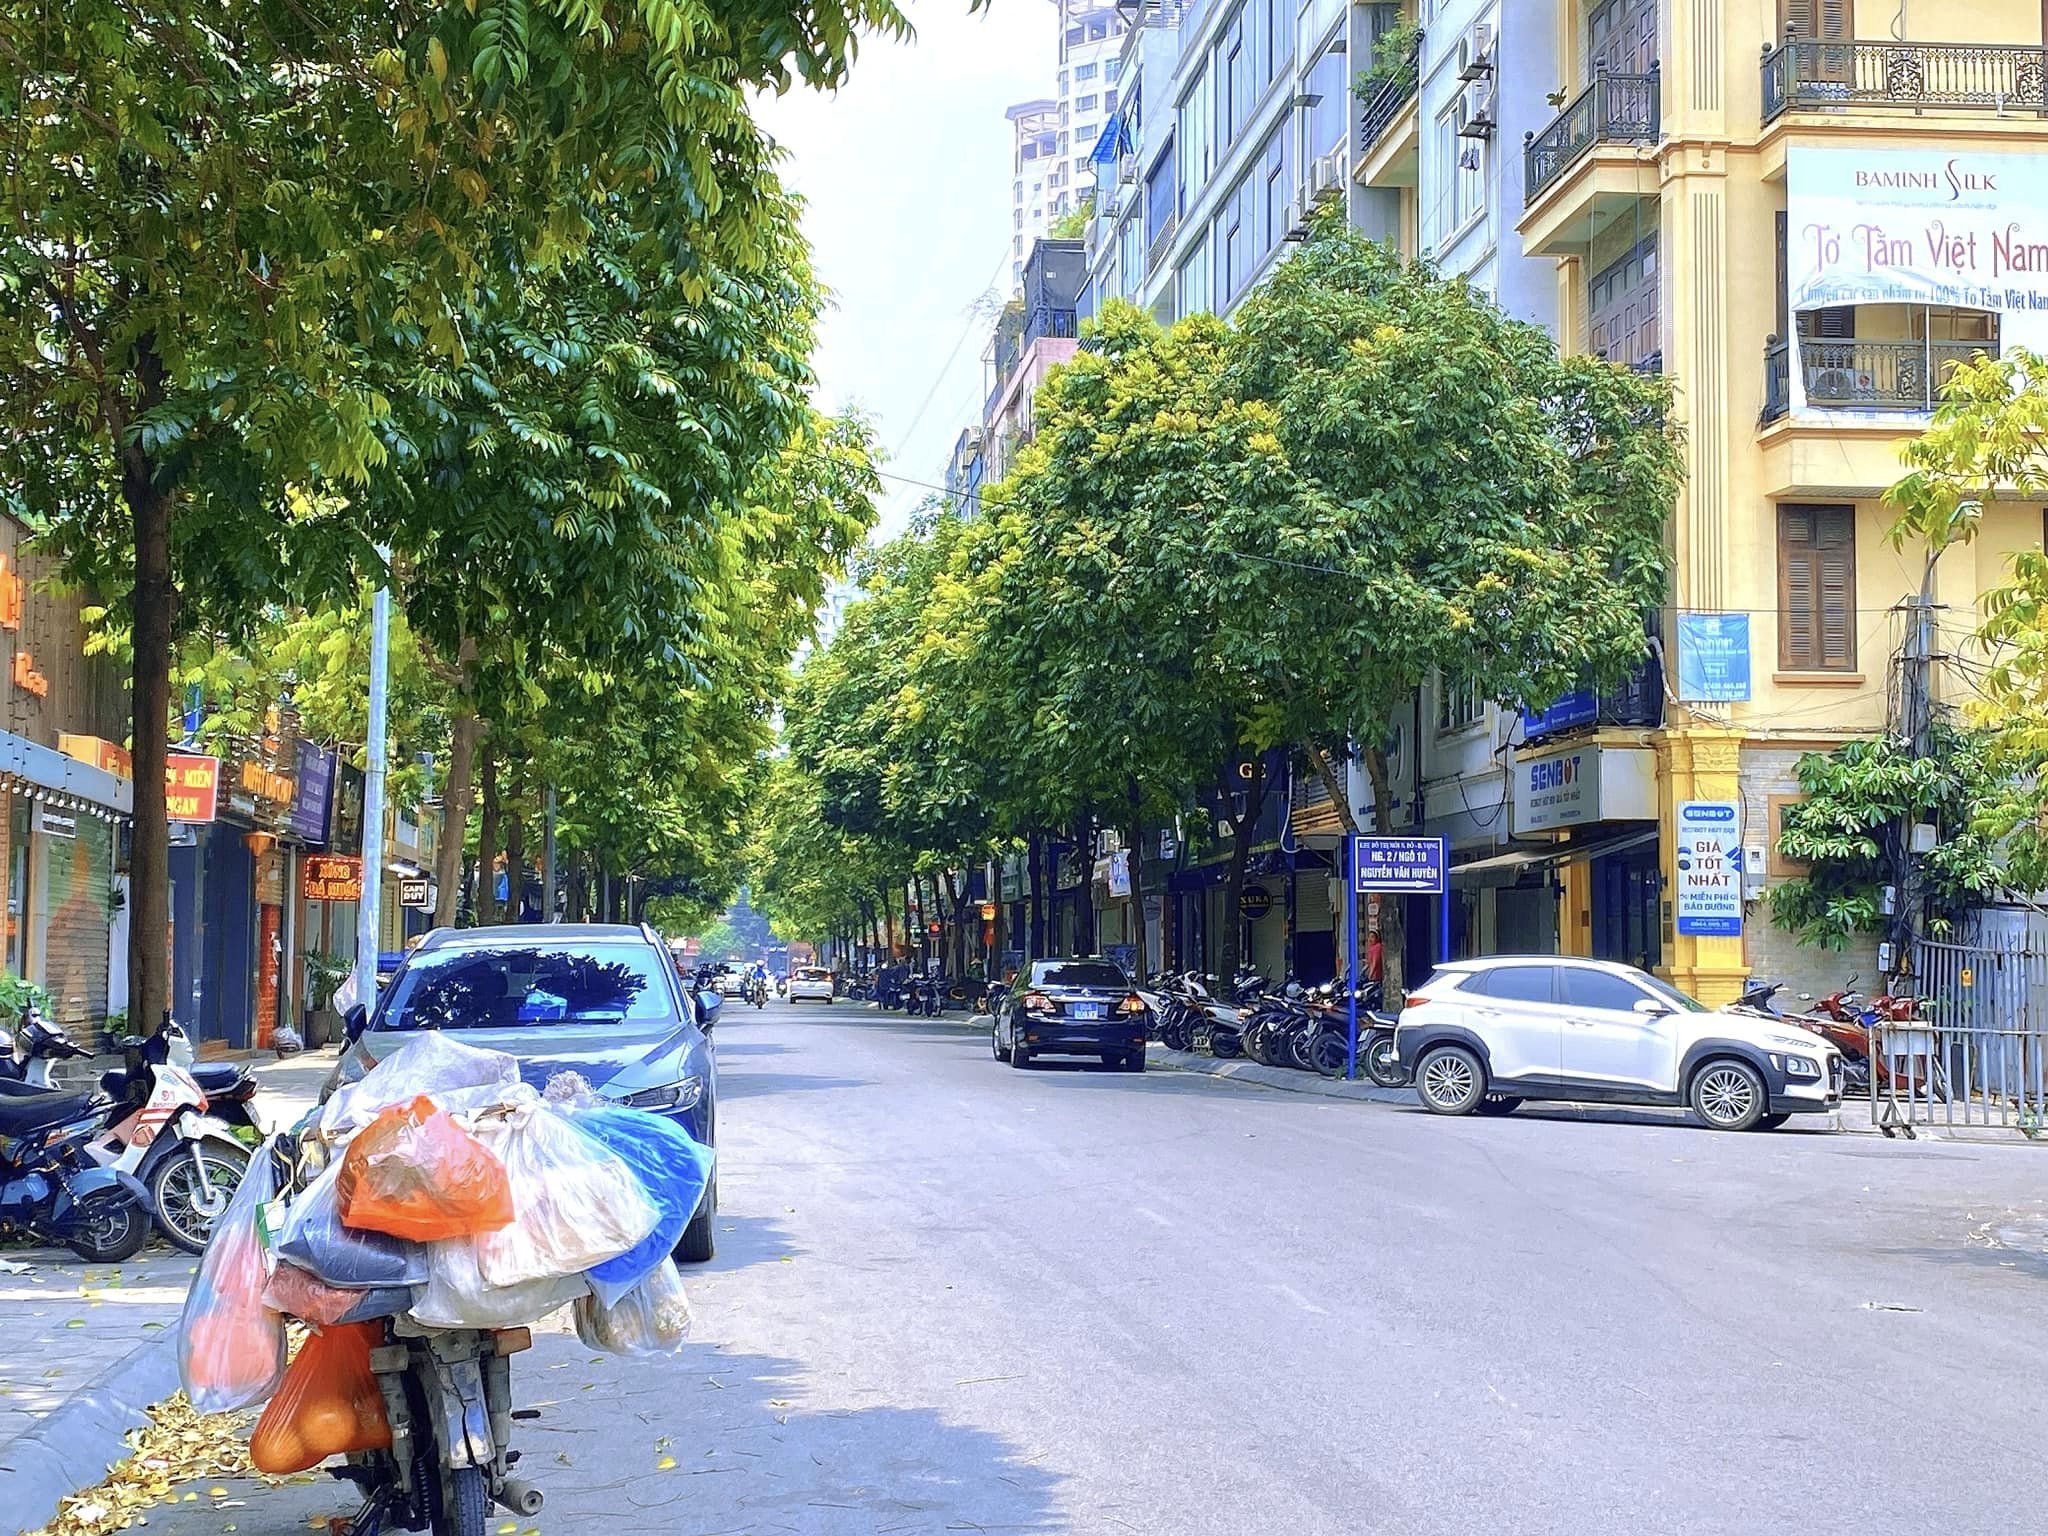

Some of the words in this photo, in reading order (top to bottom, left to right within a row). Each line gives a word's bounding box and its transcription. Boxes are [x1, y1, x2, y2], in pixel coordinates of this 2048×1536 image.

[1855, 170, 1937, 189] BAMINH
[1944, 158, 1998, 201] SILK
[1802, 223, 1841, 273] Tơ
[1925, 219, 1977, 275] Việt
[1991, 222, 2048, 278] Nam
[2005, 288, 2026, 313] Việt
[1530, 756, 1581, 792] SENBOT
[1685, 809, 1731, 818] SENBOT
[1696, 839, 1722, 853] GIÁ
[1371, 851, 1385, 862] NG.
[1387, 851, 1393, 862] 2
[1417, 851, 1427, 862] 10
[1696, 855, 1723, 870] TỐT
[1360, 864, 1393, 878] NGUYỄN
[1394, 866, 1410, 879] VĂN
[1688, 871, 1731, 886] NHẤT
[403, 892, 424, 900] DUY
